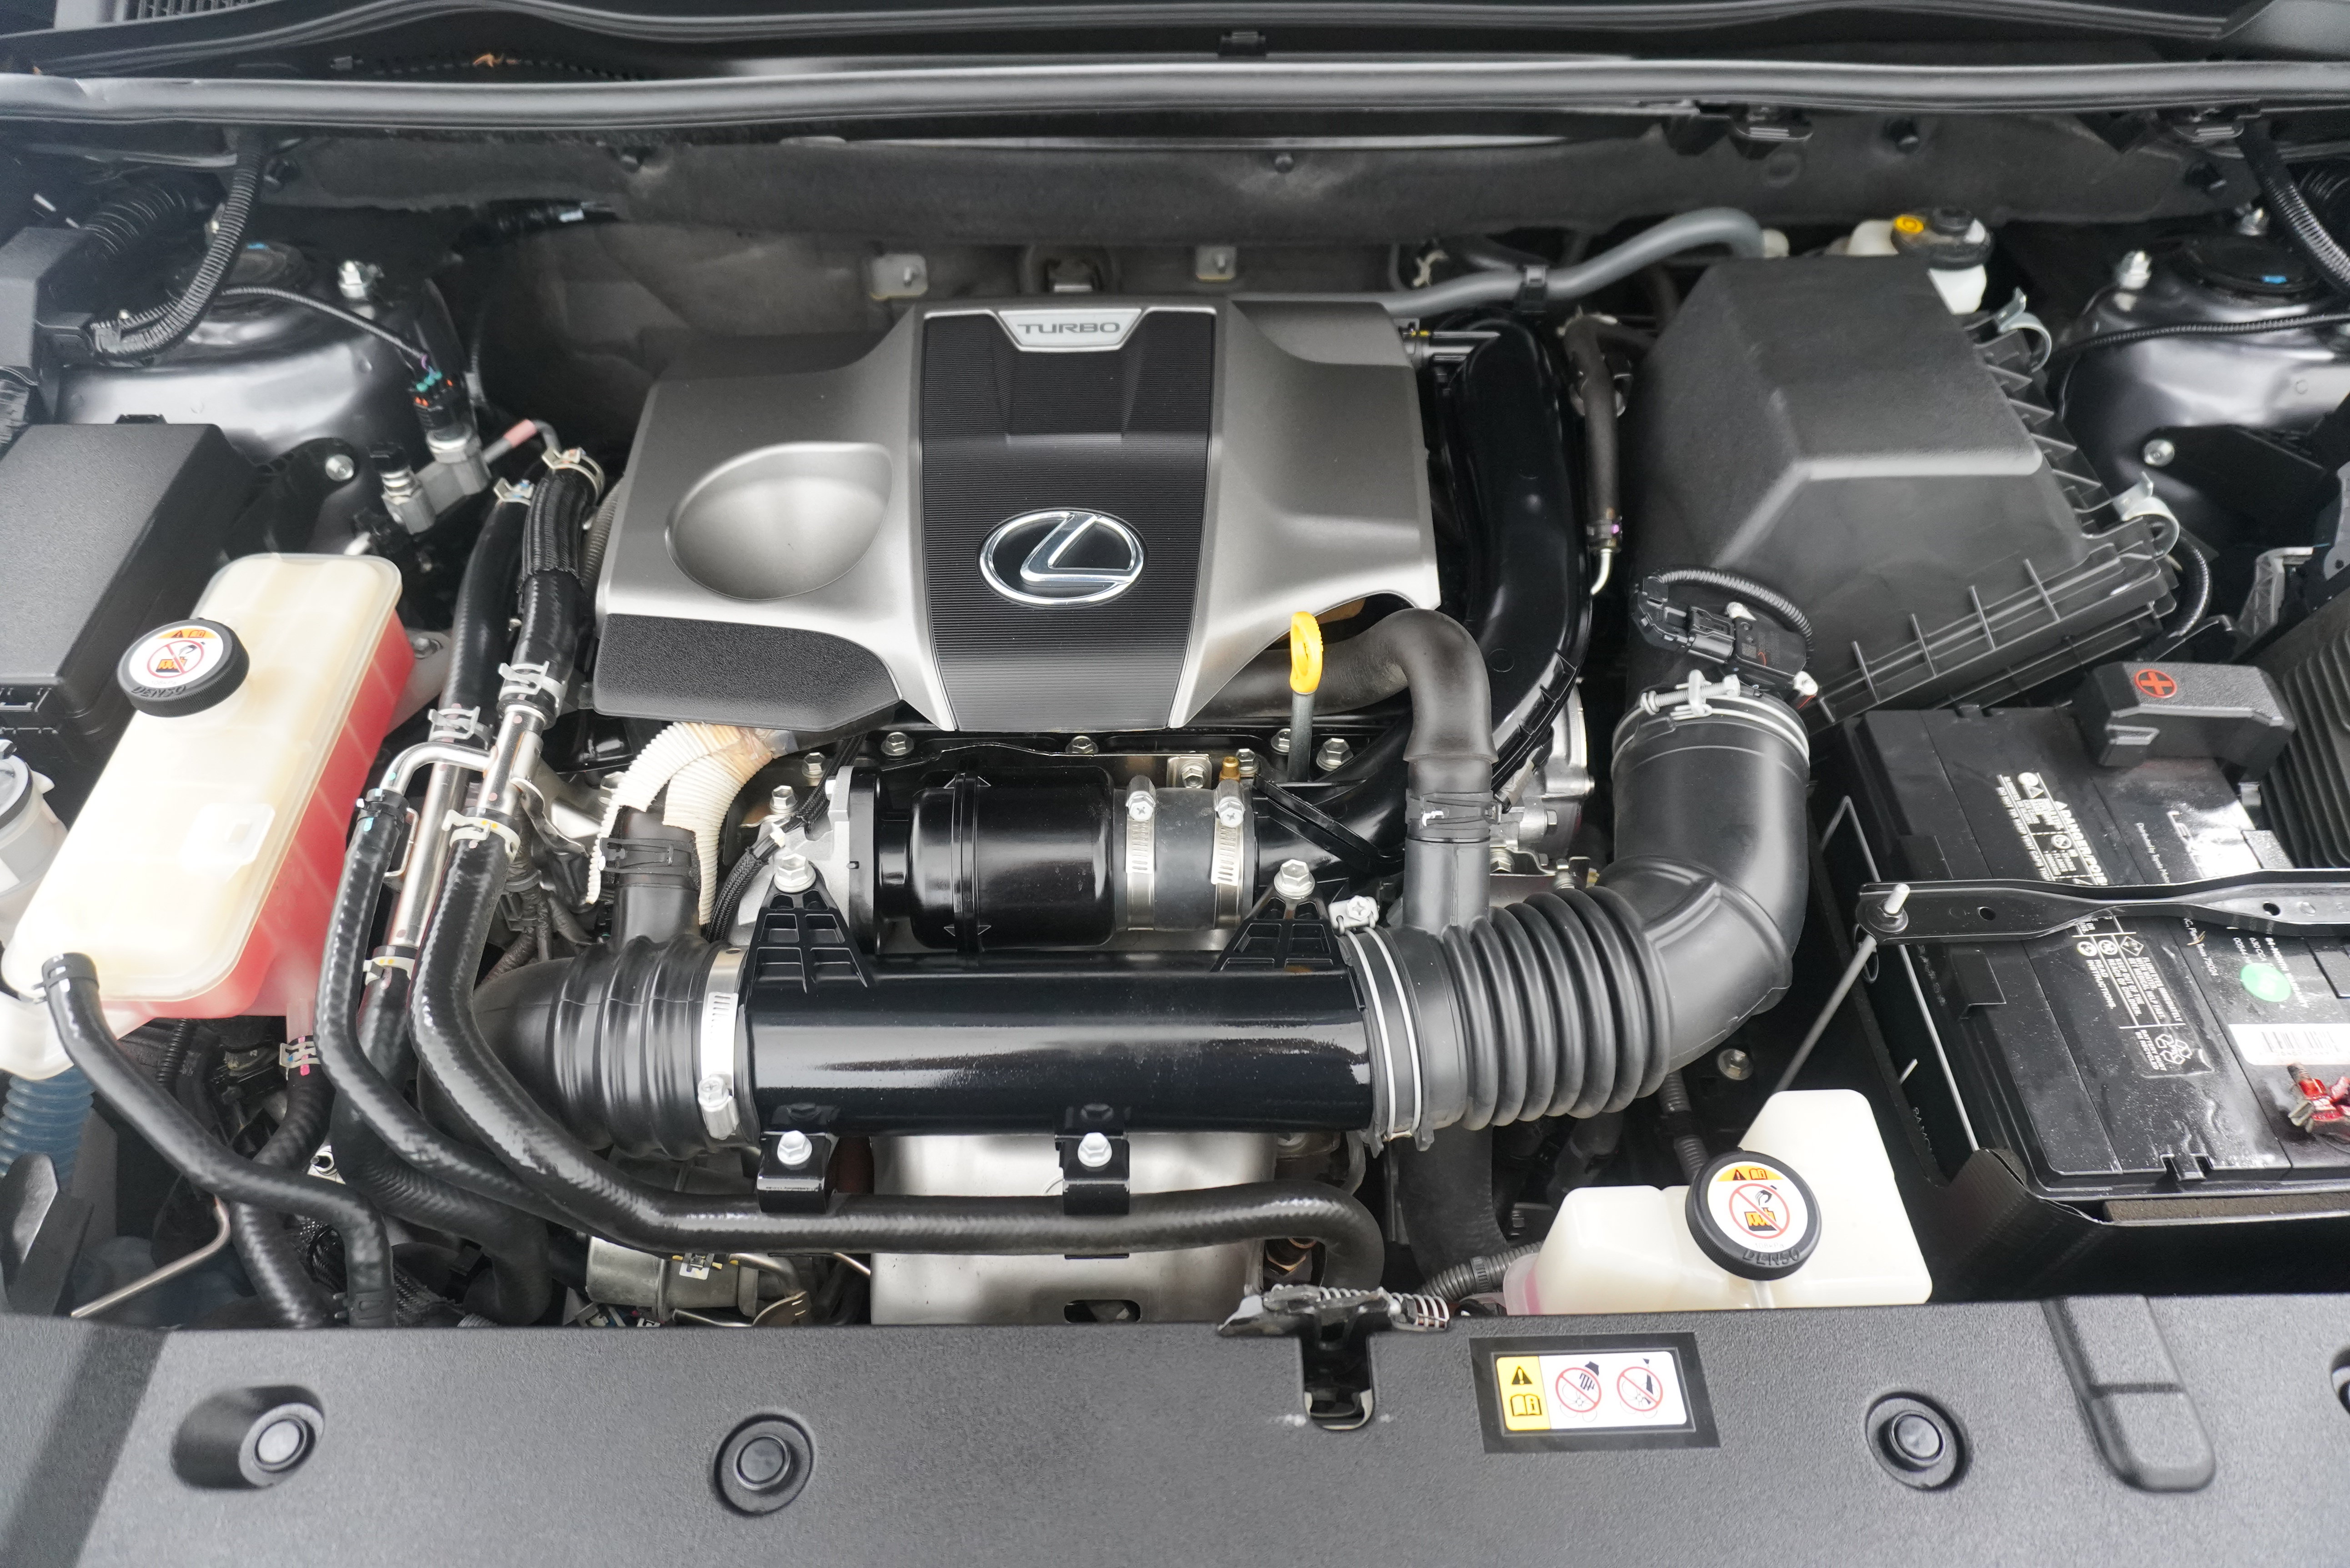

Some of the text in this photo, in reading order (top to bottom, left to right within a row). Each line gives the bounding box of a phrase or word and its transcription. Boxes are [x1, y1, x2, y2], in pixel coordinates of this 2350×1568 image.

[1017, 322, 1121, 335] TURBO
[131, 684, 187, 699] DENSO
[1996, 787, 2008, 796] DO
[2003, 777, 2021, 800] BLINDNESS
[2000, 796, 2014, 807] NOT
[2022, 799, 2040, 823] CAN CAUSE
[2042, 798, 2057, 815] SHIELD
[2036, 799, 2055, 825] EXPLOSIVE
[2012, 819, 2027, 834] KEEP
[2020, 835, 2035, 850] VENT
[2029, 851, 2044, 865] CAPS
[2052, 853, 2068, 871] FLAMES
[2060, 852, 2076, 871] SPARKS
[2136, 823, 2155, 848] Distributed
[2152, 854, 2164, 869] Toyota
[2159, 869, 2170, 883] Motor
[2039, 868, 2052, 880] TIGH
[2044, 854, 2061, 876] SMOKING
[2196, 943, 2207, 957] Texas
[2202, 956, 2219, 975] 75024
[2249, 938, 2261, 948] 630
[2255, 948, 2266, 962] CCA
[2093, 959, 2109, 978] READ
[2106, 959, 2122, 978] REACH
[2127, 958, 2139, 967] GET
[2135, 957, 2147, 970] WITH
[2265, 937, 2289, 971] 84-MONTH
[2284, 972, 2309, 1007] WARRANTY
[2114, 958, 2128, 972] KEEP
[2122, 973, 2134, 985] OUT
[2133, 993, 2145, 1005] THE
[2132, 968, 2150, 990] MEDICAL
[2141, 957, 2183, 1021] FLUSH EYES IMMEDIATELY
[2144, 991, 2159, 1003] HELP
[2139, 1040, 2159, 1070] RECYCLED
[2140, 1030, 2167, 1070] BATTERY MUST
[1742, 1248, 1800, 1266] DENSO
